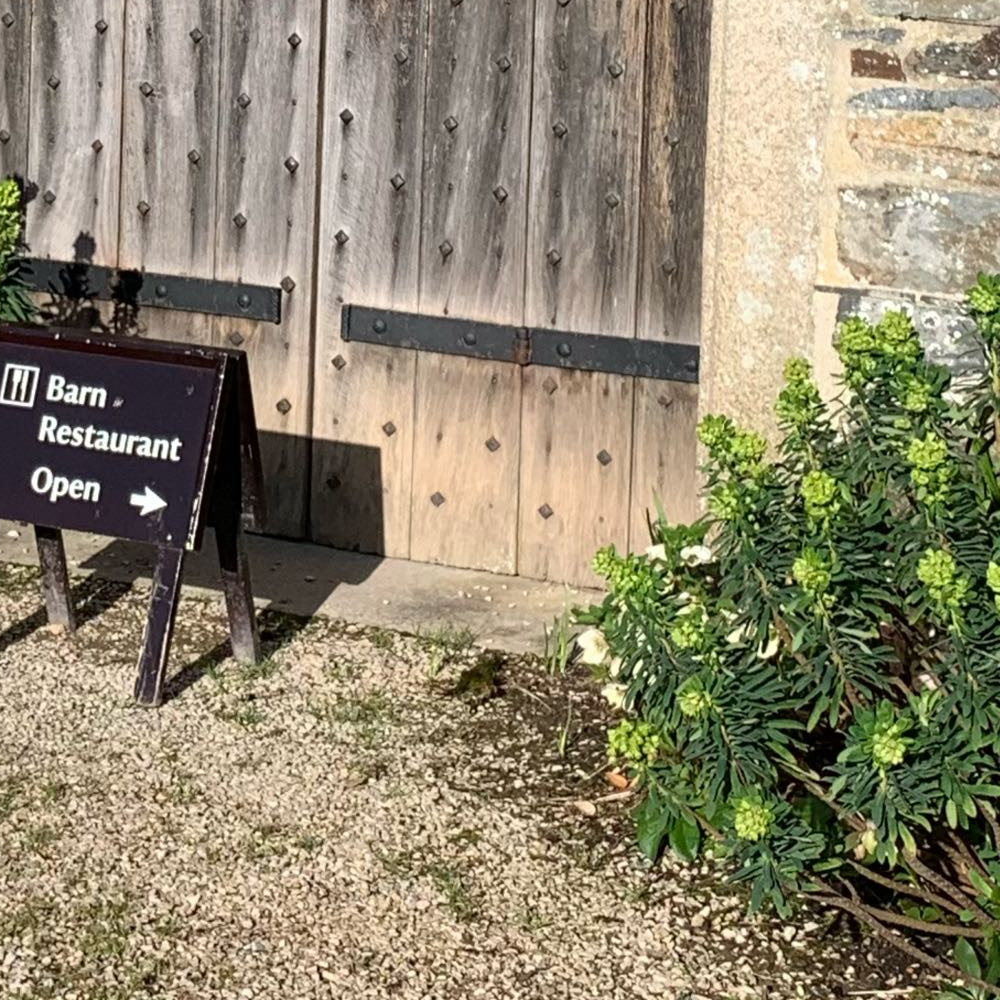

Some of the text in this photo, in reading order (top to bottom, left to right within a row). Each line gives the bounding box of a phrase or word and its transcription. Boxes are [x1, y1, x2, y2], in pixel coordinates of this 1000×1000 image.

[46, 374, 107, 408] Barn
[38, 415, 182, 462] Restaurant
[30, 466, 101, 502] Open
